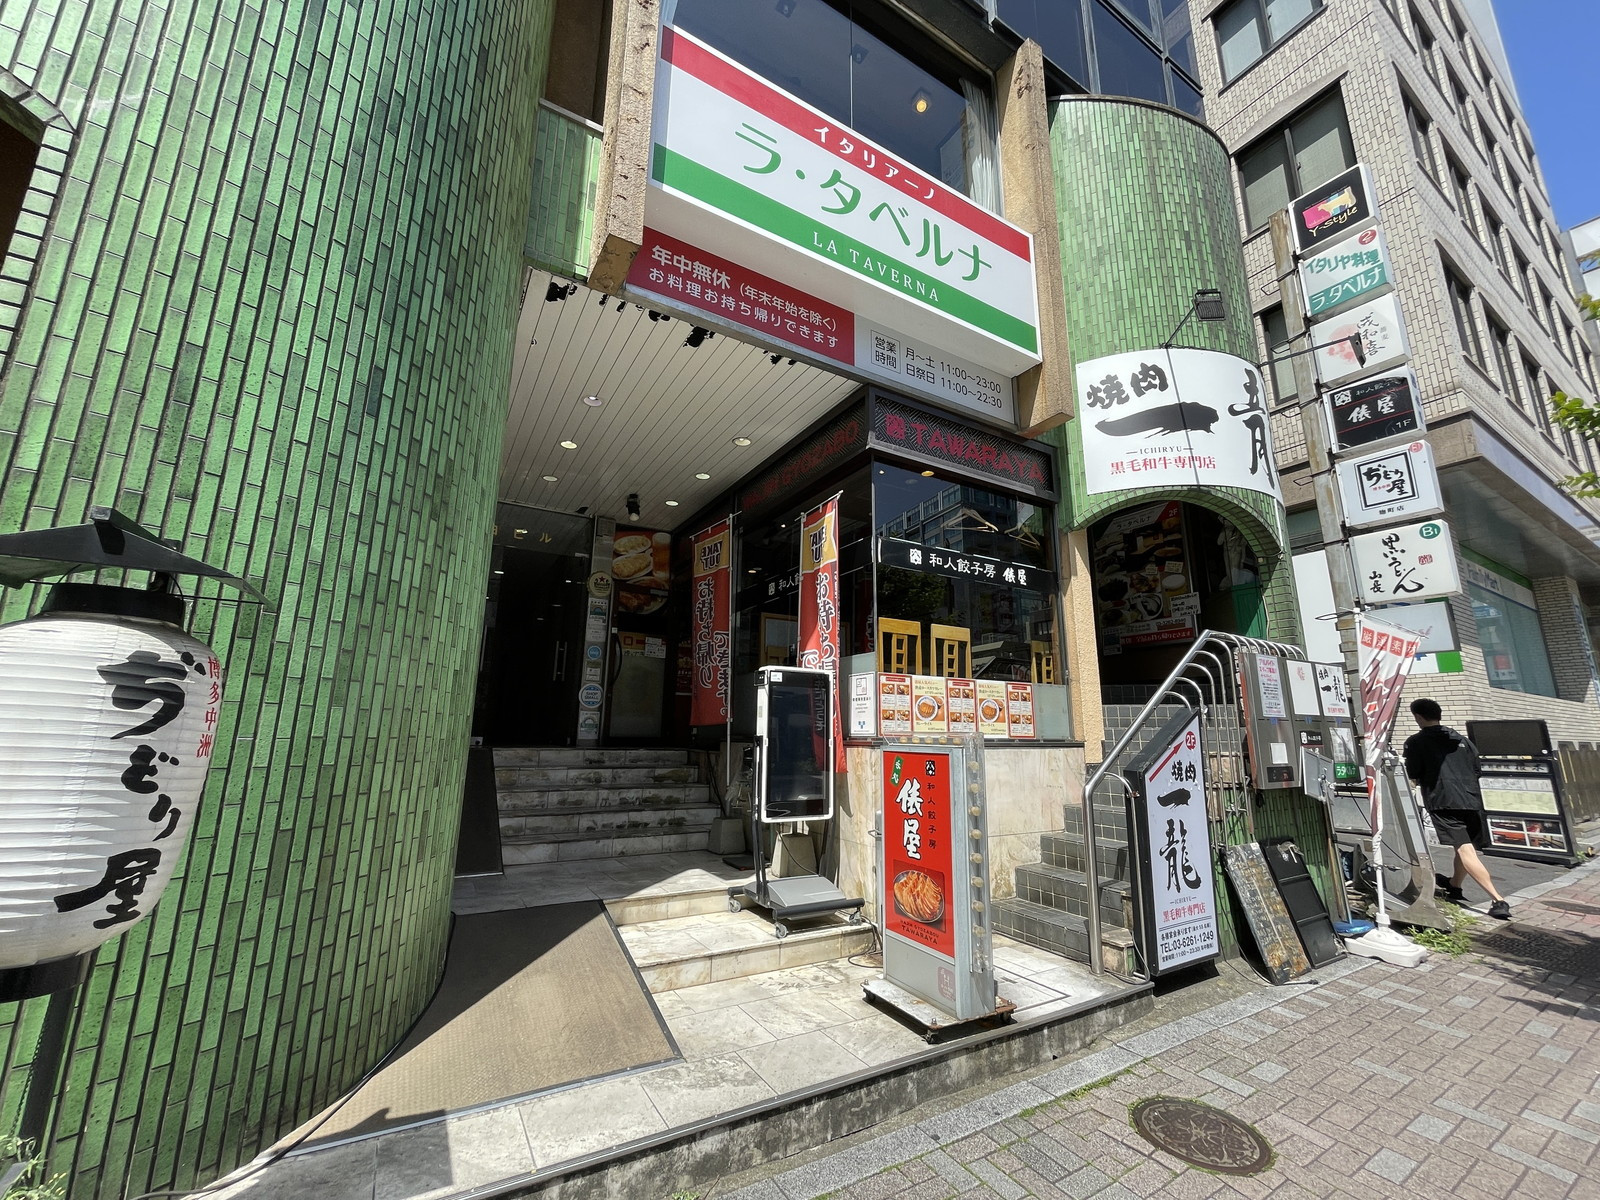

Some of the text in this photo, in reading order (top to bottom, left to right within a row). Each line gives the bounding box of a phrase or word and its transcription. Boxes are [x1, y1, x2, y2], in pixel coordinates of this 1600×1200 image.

[814, 126, 937, 200] イタリアーノ
[735, 122, 992, 282] ラ・タベルナ
[651, 245, 731, 290] 年中無休
[813, 231, 940, 302] LA TAVERNA
[650, 268, 838, 348] お料理お持ち帰りできます
[875, 336, 896, 354] 営業
[875, 350, 896, 369] 時間
[906, 363, 935, 384] 日祭日
[1348, 396, 1396, 423] 俵屋
[1396, 419, 1412, 428] 1F
[910, 423, 1045, 484] TAWARAYA
[1140, 445, 1183, 455] ICHIRYU
[1110, 455, 1216, 475] 黒毛和牛専門店
[1422, 526, 1438, 538] B1
[929, 552, 1027, 586] 和人餃子房 俵屋
[1369, 571, 1385, 594] 山長
[196, 656, 221, 758] 博多中洲
[896, 777, 923, 860] 俵屋
[927, 782, 937, 849] 和人餃子房
[1163, 902, 1206, 923] 黒毛和牛専門店
[901, 925, 938, 945] TAWARAYA
[1160, 930, 1214, 954] TEL:03-6261-1249
